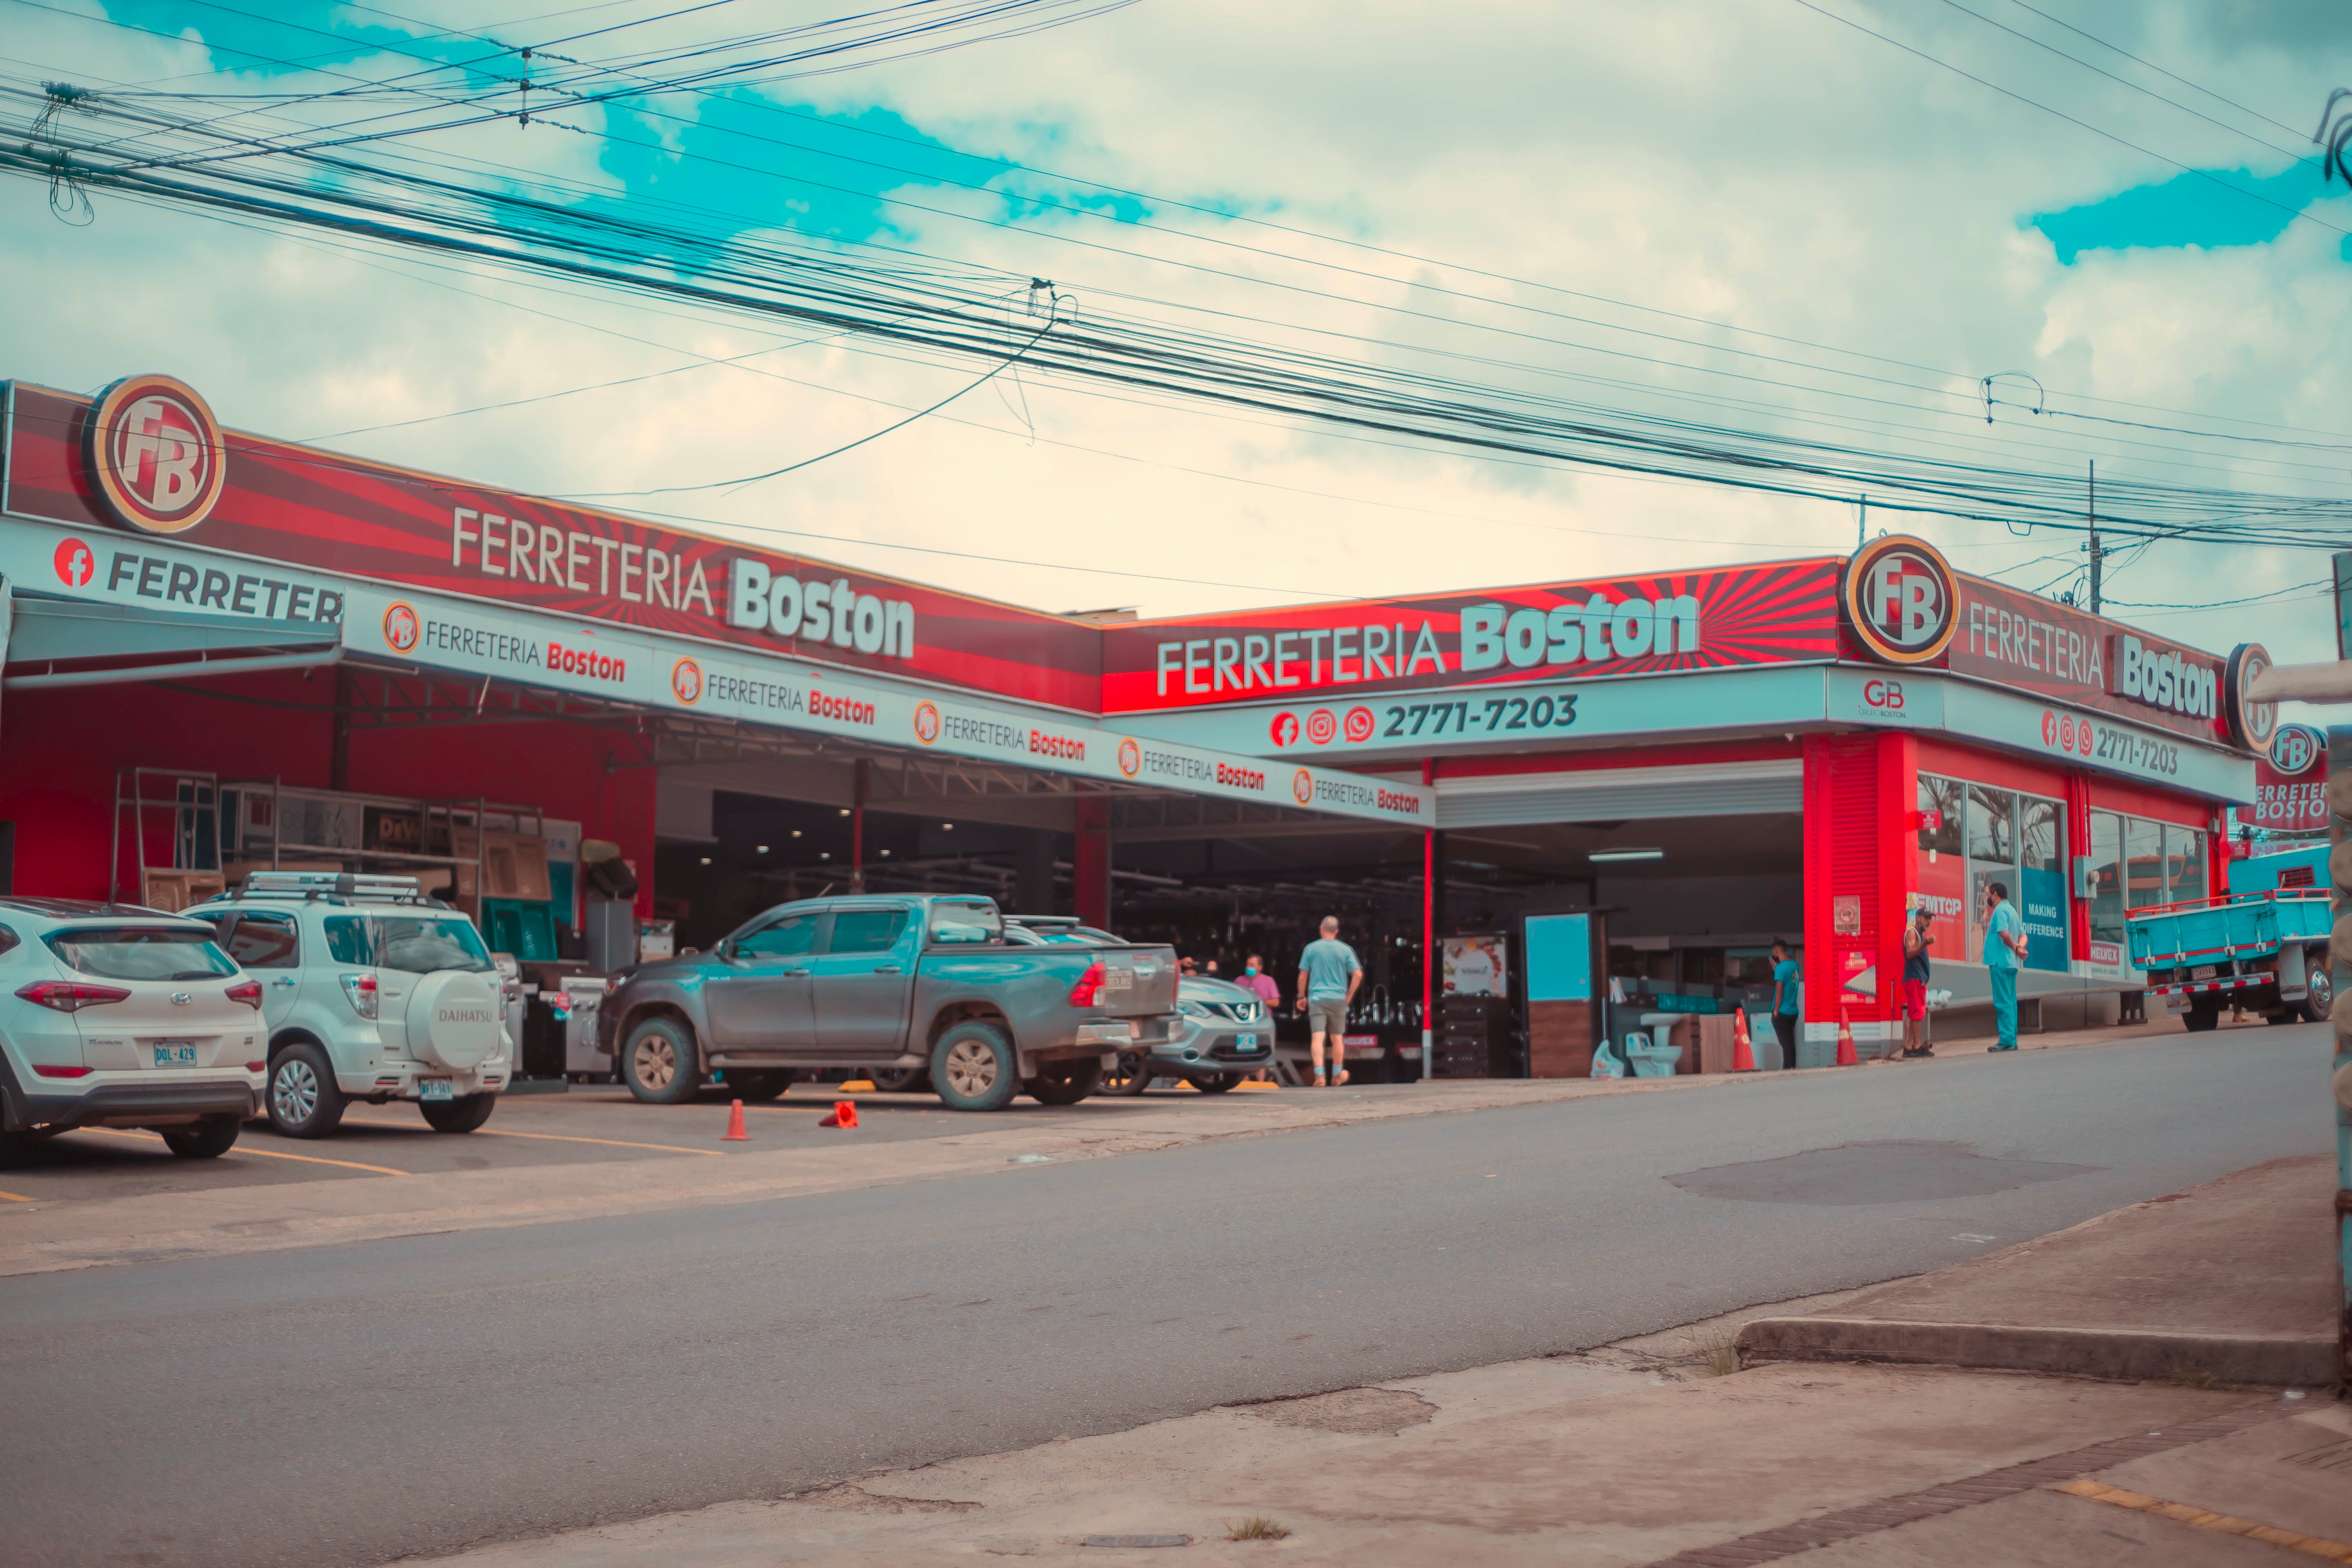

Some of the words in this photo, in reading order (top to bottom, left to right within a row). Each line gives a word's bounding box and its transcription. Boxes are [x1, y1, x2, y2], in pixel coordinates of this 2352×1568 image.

[122, 401, 199, 512] FB
[453, 506, 715, 617] FERRETERIA
[729, 558, 915, 659] Boston
[1874, 559, 1938, 645] FB
[426, 621, 540, 666] FERRETERIA
[547, 642, 626, 683] Boston
[1158, 620, 1446, 696] FERRETERIA
[1460, 593, 1700, 672] Boston
[1969, 601, 2104, 688] FERRETERIA
[2120, 633, 2216, 719] Boston
[708, 674, 803, 712] FERRETERIA
[809, 690, 875, 725] Boston
[1383, 693, 1578, 738] 2771-7203
[1864, 679, 1904, 709] GB
[944, 716, 1025, 750] FERRETERIA
[1029, 730, 1085, 761] Boston
[2097, 727, 2178, 775] 2771-7203
[1144, 751, 1213, 782] FERRETERIA
[1216, 762, 1265, 791] Boston
[1316, 780, 1374, 807] FERRETERIA
[1377, 788, 1419, 814] Boston
[2256, 799, 2330, 819] BOSTO
[2022, 922, 2064, 938] DIFFERENCE
[2029, 903, 2056, 918] MAKING
[2091, 946, 2118, 962] HELVEX
[439, 1009, 492, 1022] DAIHATSU
